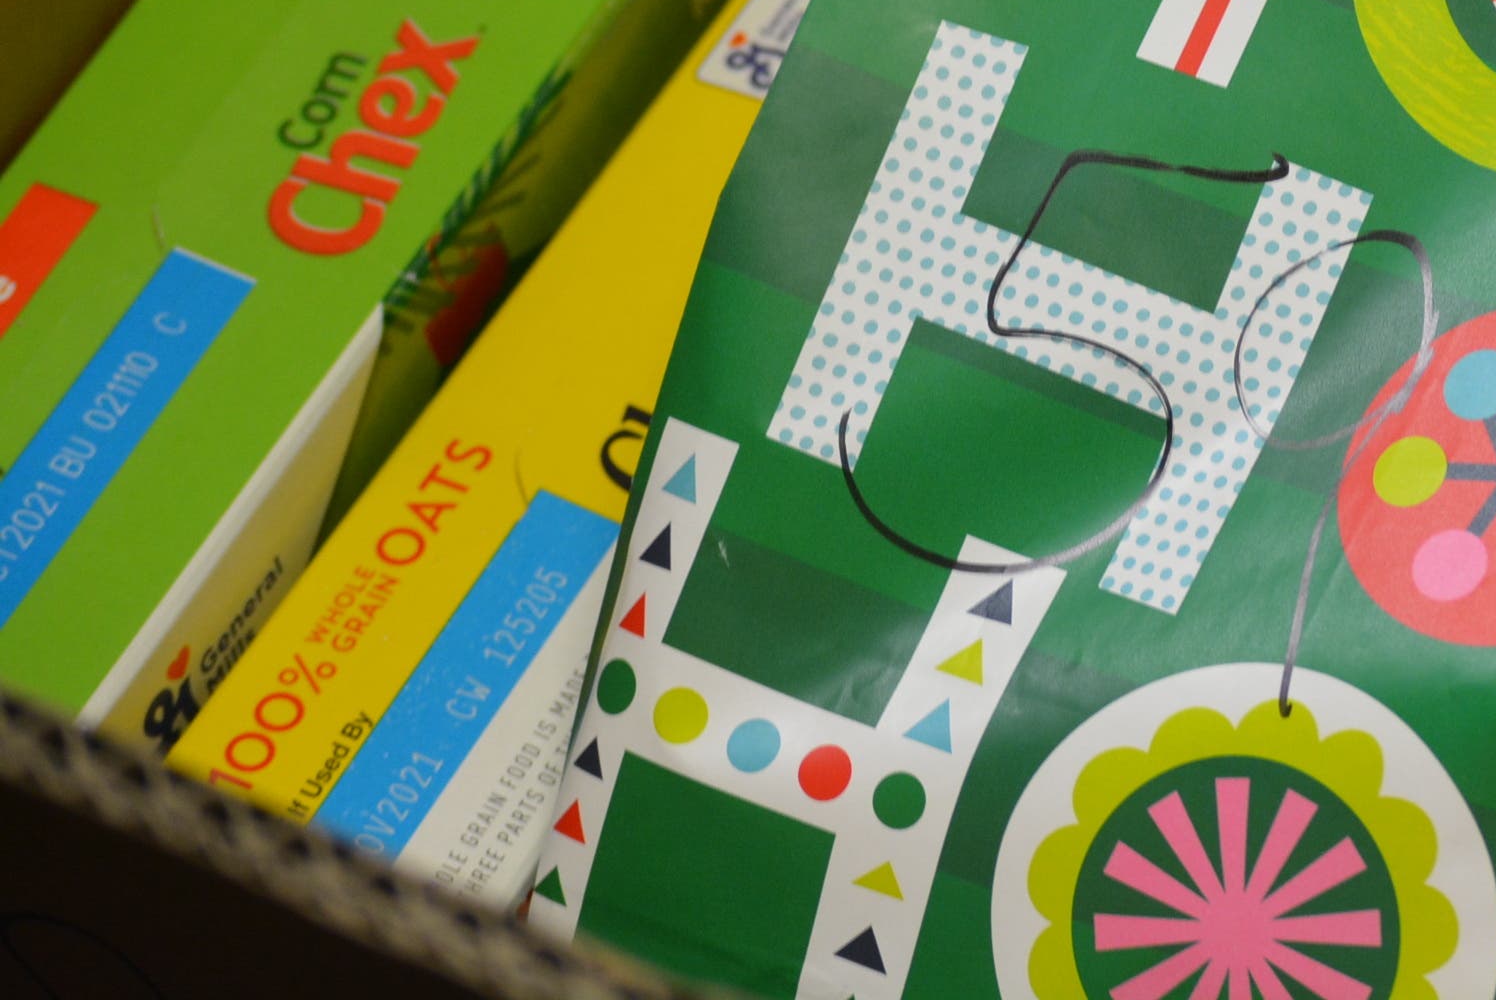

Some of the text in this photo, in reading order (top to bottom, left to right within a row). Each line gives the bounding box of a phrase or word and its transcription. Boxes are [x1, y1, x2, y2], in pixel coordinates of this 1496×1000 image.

[267, 18, 482, 256] Chex
[279, 52, 368, 152] Corn
[49, 435, 97, 479] BU
[82, 351, 158, 431] 021110
[152, 311, 188, 336] C
[375, 439, 493, 566] OATS
[200, 556, 284, 672] General
[305, 565, 375, 644] WHOLE
[331, 575, 400, 653] GRAIN
[209, 653, 337, 791] 100%
[287, 710, 374, 817] If Used By
[353, 566, 568, 854] OV2021 CW 125205
[436, 850, 467, 884] OLE
[460, 792, 505, 849] GRAIN
[500, 741, 541, 790] FOOD
[538, 720, 557, 739] IS
[497, 785, 545, 845] PARTS
[538, 764, 562, 786] OF
